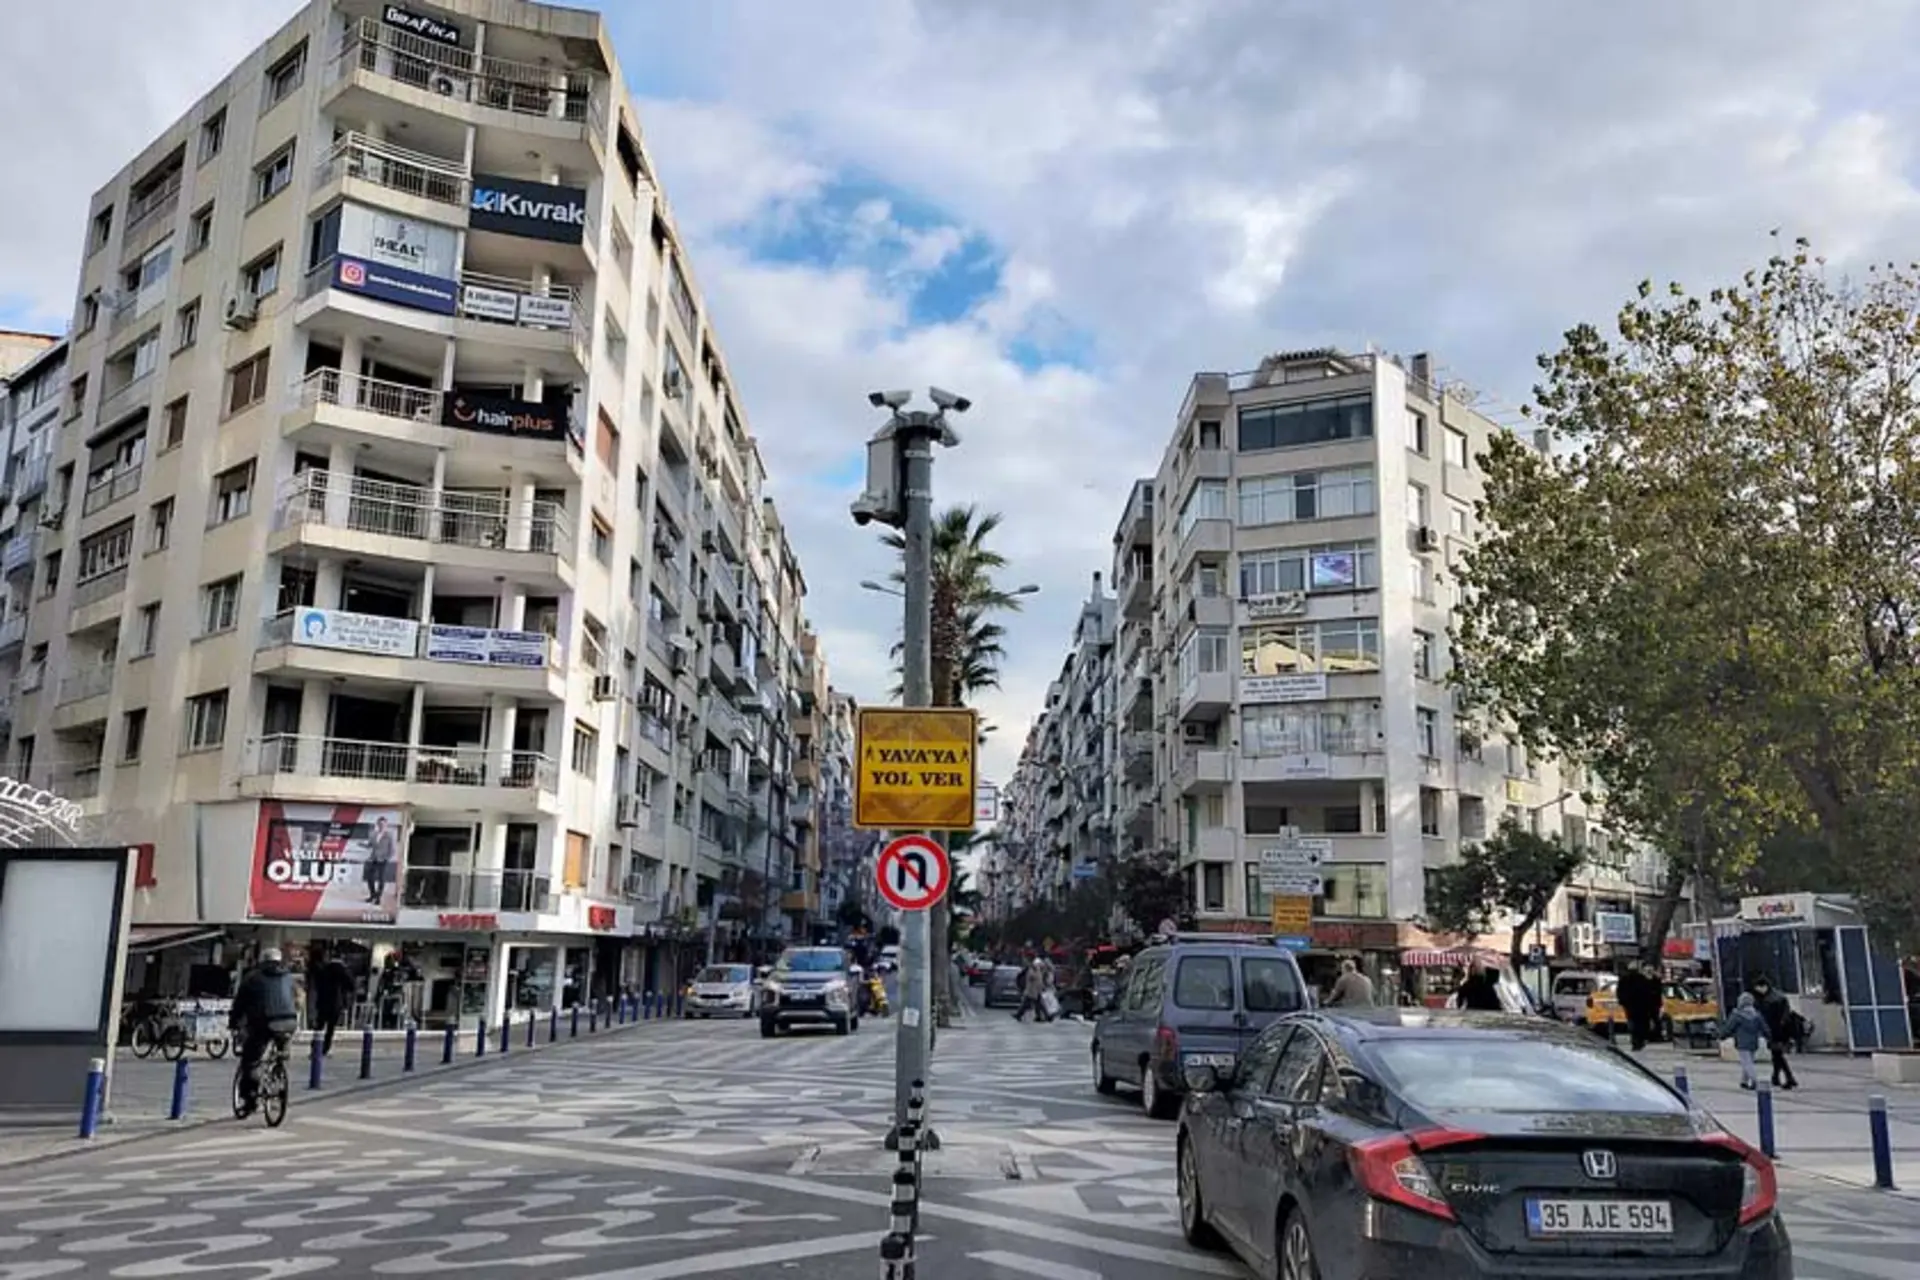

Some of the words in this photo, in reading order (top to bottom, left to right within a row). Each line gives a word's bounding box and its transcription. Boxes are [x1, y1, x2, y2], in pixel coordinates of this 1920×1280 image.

[879, 749, 957, 764] YAYA'YA
[872, 771, 912, 786] YOL
[920, 771, 964, 787] VER
[1543, 1204, 1569, 1228] 35
[1582, 1204, 1621, 1228] AJE
[1628, 1204, 1668, 1229] 594
